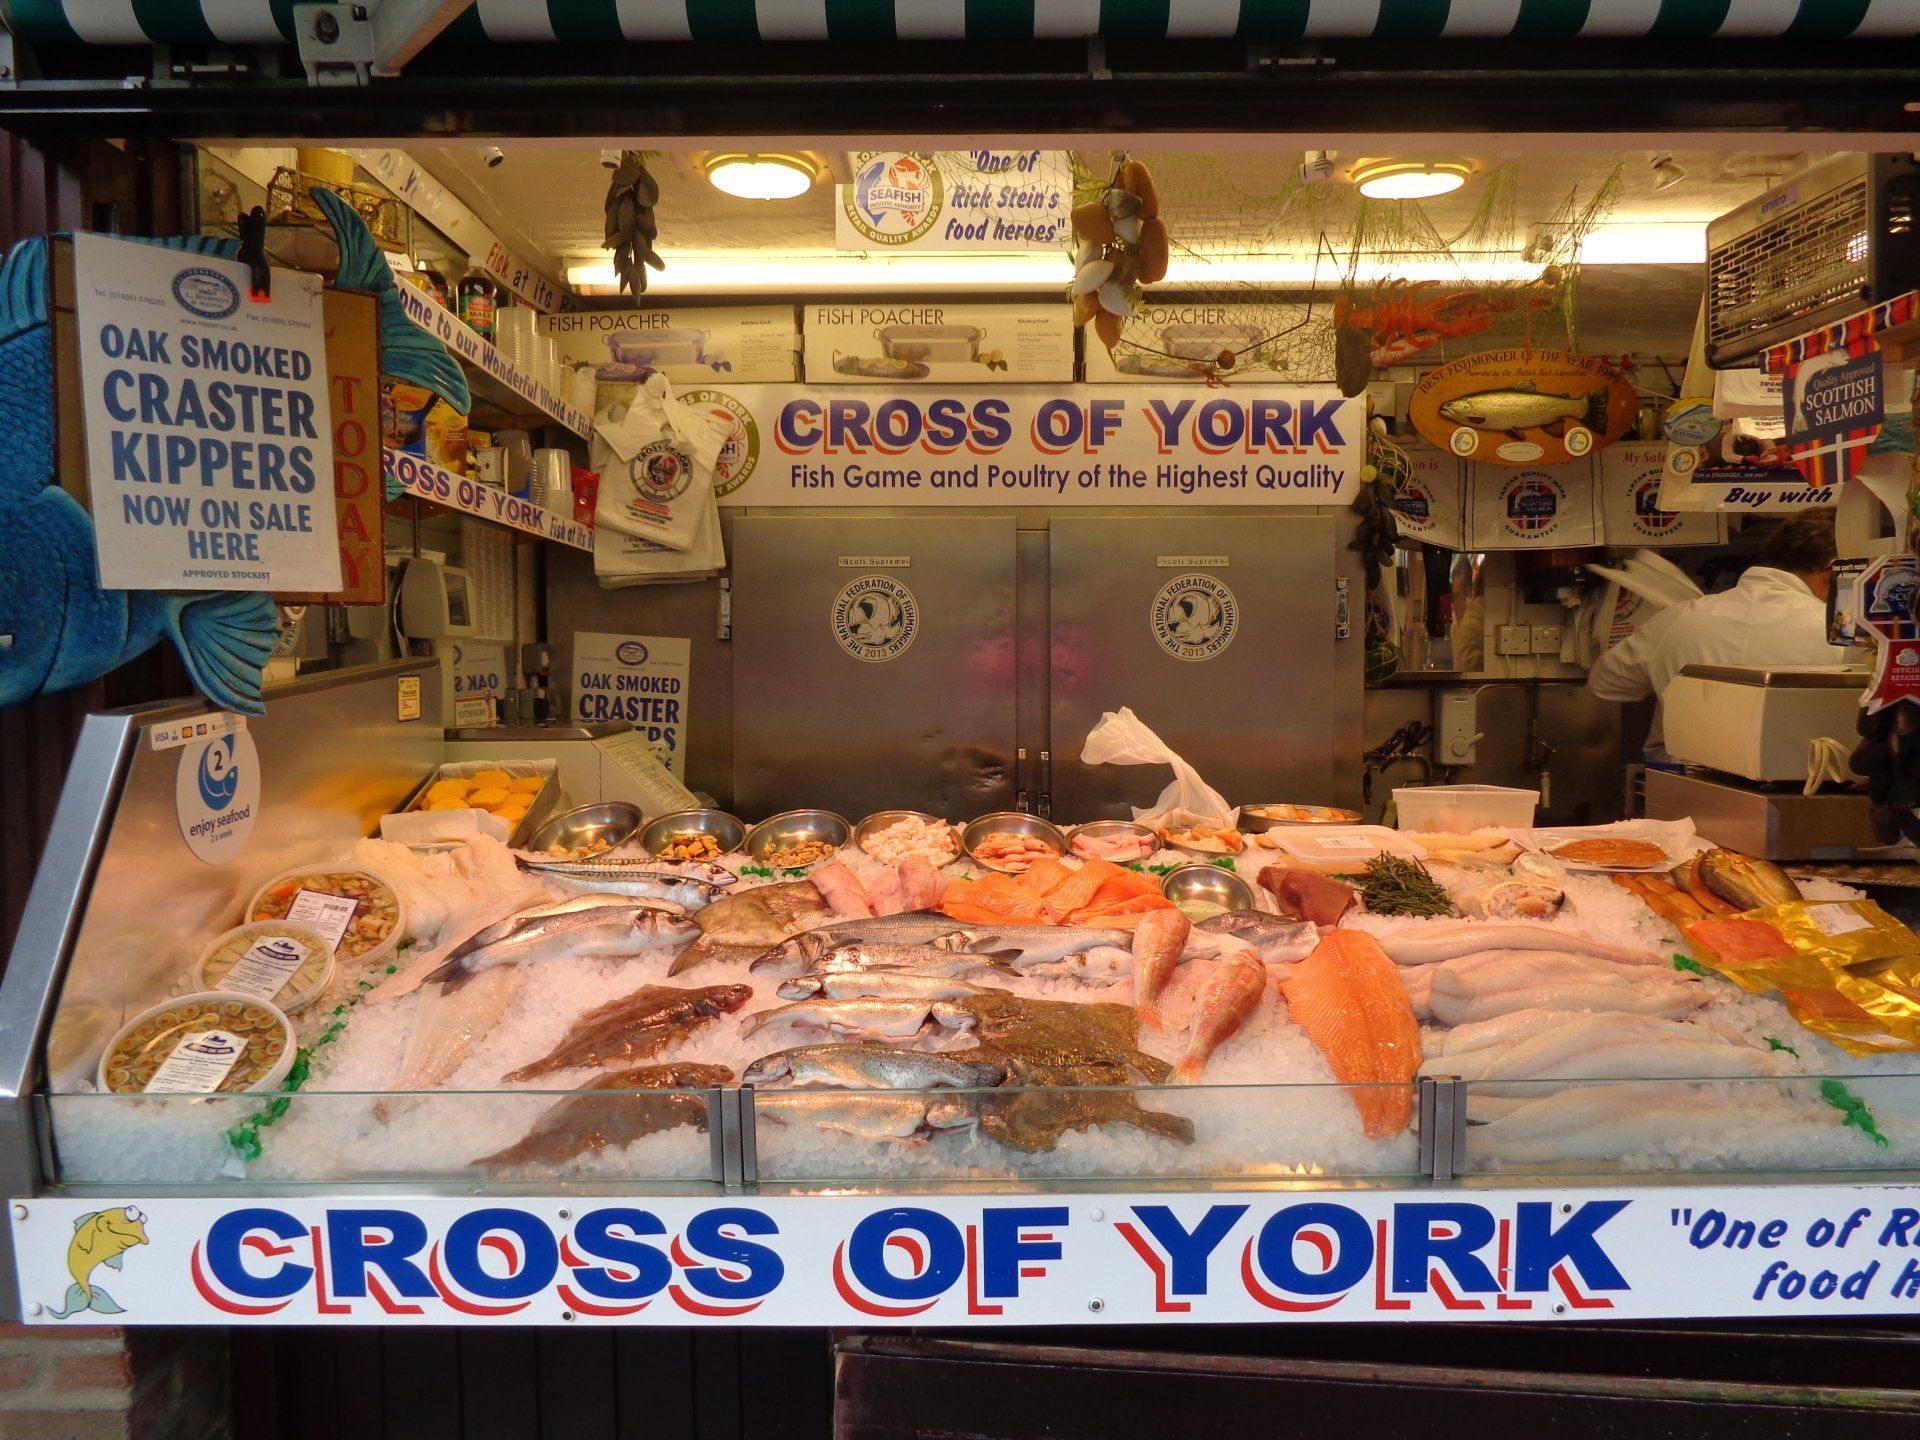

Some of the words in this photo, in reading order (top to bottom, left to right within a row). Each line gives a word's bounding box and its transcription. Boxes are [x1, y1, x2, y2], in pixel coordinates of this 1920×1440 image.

[970, 150, 1012, 172] "One
[1017, 150, 1040, 173] of
[870, 189, 921, 203] SEAFISH
[951, 184, 992, 208] Rick
[996, 184, 1060, 208] Stein's
[846, 204, 868, 234] RETAIL
[869, 229, 908, 243] QUALITY
[911, 204, 938, 238] AWARDS
[945, 218, 989, 241] food
[992, 218, 1065, 241] heroes"
[513, 269, 530, 292] at
[533, 280, 553, 308] its
[469, 310, 492, 318] MALT
[550, 315, 583, 332] FISH
[590, 313, 671, 331] POACHER
[817, 308, 854, 325] FISH
[860, 308, 945, 325] POACHER
[1148, 308, 1227, 325] POACHER
[100, 324, 171, 365] OAK
[181, 335, 311, 382] SMOKED
[436, 311, 452, 341] to
[456, 329, 479, 360] our
[482, 340, 537, 402] Wonderful
[540, 383, 566, 420] World
[567, 404, 577, 429] of
[1419, 371, 1446, 395] BEST
[1446, 350, 1518, 376] FISHMONGER
[1540, 350, 1561, 363] THE
[1565, 352, 1594, 372] YEAR
[1595, 364, 1621, 385] 1989
[1813, 375, 1839, 391] Quality
[1841, 361, 1875, 383] Approved
[103, 369, 318, 440] CRASTER
[700, 391, 717, 402] OF
[722, 394, 752, 424] YORK
[1806, 376, 1876, 411] SCOTTISH
[1815, 396, 1876, 426] SALMON
[774, 399, 1012, 455] CROSS
[1030, 399, 1125, 455] OF
[1142, 399, 1348, 455] YORK
[111, 430, 316, 495] KIPPERS
[726, 456, 756, 491] AWARDS
[1622, 452, 1641, 467] My
[333, 374, 370, 589] TODAY
[791, 464, 834, 488] Fish
[843, 464, 922, 488] Game
[930, 464, 978, 488] and
[987, 464, 1070, 493] Poultry
[1077, 464, 1101, 488] of
[1108, 464, 1147, 488] the
[1156, 464, 1248, 494] Highest
[1255, 464, 1345, 494] Quality
[1498, 475, 1519, 500] TARTAN
[1520, 470, 1553, 481] QUALITY
[1552, 479, 1567, 499] MARK
[1626, 471, 1647, 497] TARTAN
[382, 450, 451, 500] ROSS
[456, 479, 487, 512] OF
[492, 490, 545, 534] YORK
[550, 516, 566, 541] Fish
[567, 524, 576, 544] at
[576, 527, 587, 548] its
[1723, 487, 1773, 507] Buy
[1779, 486, 1833, 502] with
[122, 494, 190, 527] NOW
[200, 498, 241, 530] ON
[249, 501, 313, 533] SALE
[1632, 520, 1684, 537] GUARANTEED
[188, 530, 260, 562] HERE
[1504, 522, 1560, 540] GUARANTEED
[182, 569, 229, 579] APPROVED
[231, 570, 270, 583] STOCKIST
[846, 579, 896, 599] FEDERATION
[1166, 578, 1217, 597] FEDERATION
[895, 589, 908, 601] OF
[1216, 589, 1229, 601] OF
[836, 598, 850, 641] NATIONAL
[888, 600, 915, 654] FISHMONGERS
[1155, 596, 1170, 640] NATIONAL
[1206, 600, 1234, 654] FISHMONGERS
[846, 639, 863, 655] THE
[864, 648, 887, 658] 2013
[1164, 637, 1181, 653] THE
[1181, 647, 1205, 657] 2013
[581, 672, 611, 690] OAK
[616, 674, 681, 695] SMOKED
[579, 694, 680, 724] CRASTER
[154, 731, 169, 743] VISA
[214, 750, 223, 771] 2
[189, 819, 216, 837] enjoy
[217, 804, 251, 828] seafood
[219, 830, 233, 840] week
[1671, 1208, 1788, 1249] "One
[1805, 1207, 1872, 1249] of
[191, 1207, 785, 1317] CROSS
[832, 1204, 1070, 1317] OF
[1113, 1199, 1635, 1313] YORK
[1752, 1259, 1881, 1301] food
